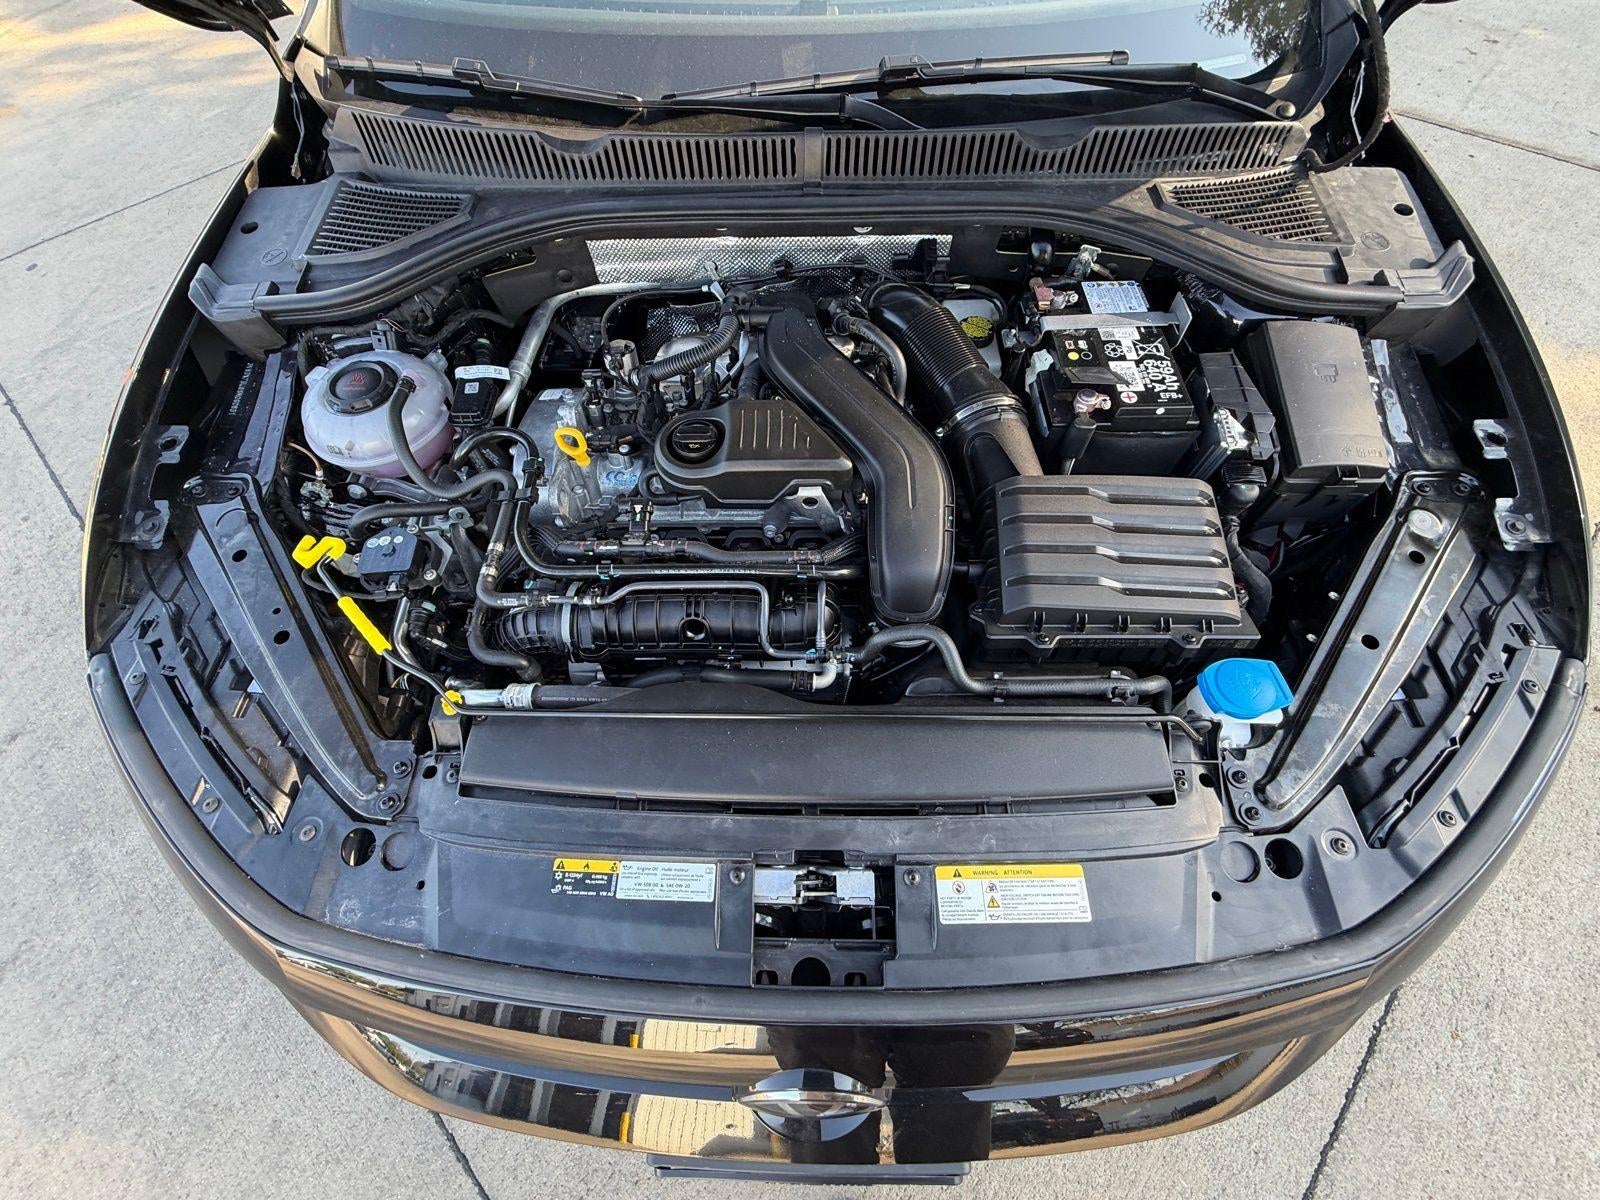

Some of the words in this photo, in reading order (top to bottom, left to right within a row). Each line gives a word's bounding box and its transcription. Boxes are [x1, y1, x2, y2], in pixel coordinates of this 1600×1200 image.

[1143, 359, 1162, 381] 640
[1157, 360, 1180, 391] 59Ah
[1152, 382, 1167, 392] A
